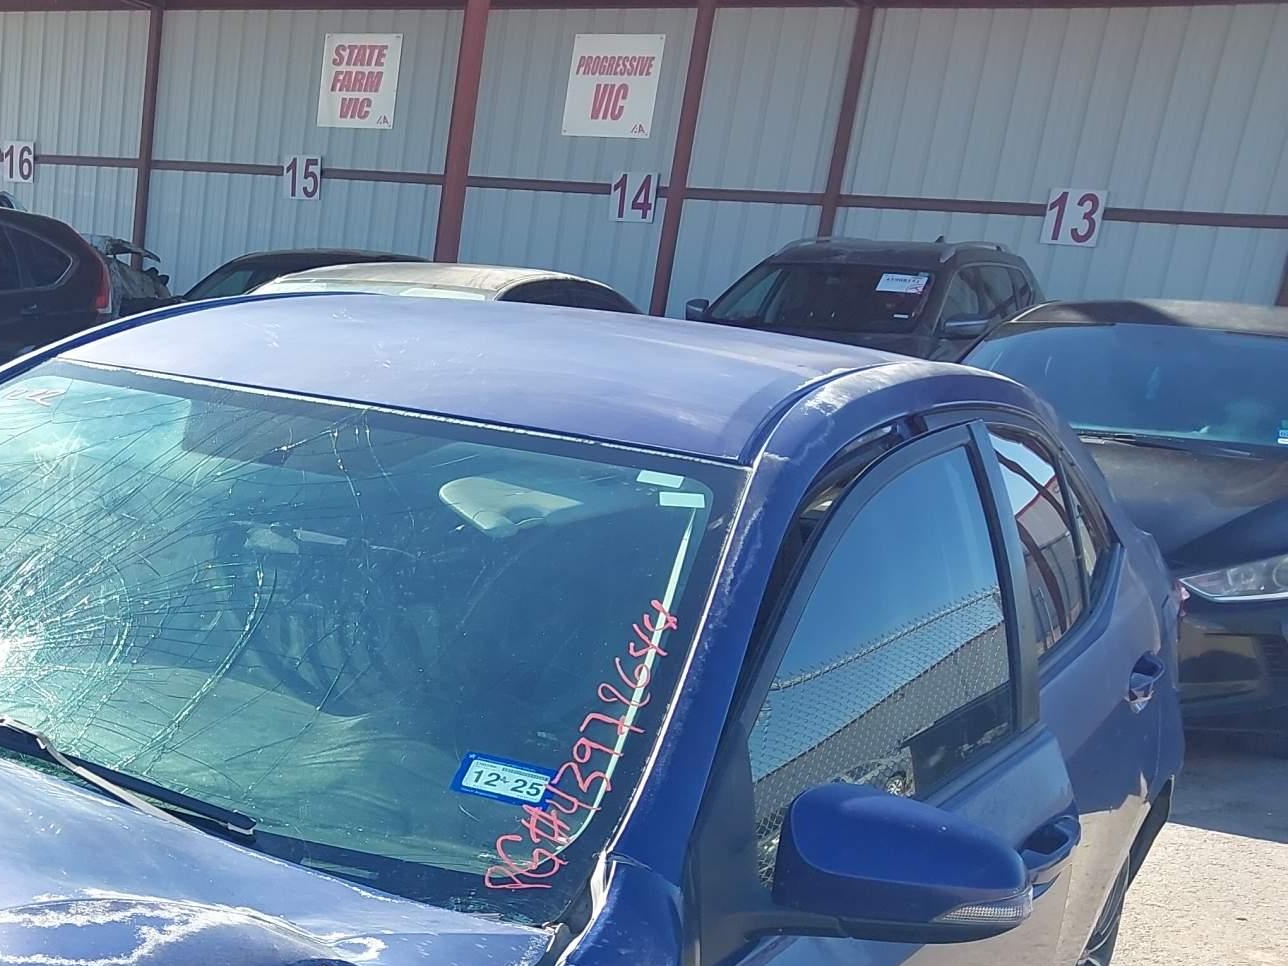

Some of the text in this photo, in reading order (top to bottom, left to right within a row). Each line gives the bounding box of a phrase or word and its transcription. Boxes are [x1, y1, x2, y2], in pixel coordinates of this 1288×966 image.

[332, 44, 389, 67] STATE
[575, 55, 656, 77] PROGRESSIVE
[330, 70, 384, 93] FARM
[339, 97, 373, 120] VIC
[591, 83, 629, 121] VIC
[4, 144, 33, 181] 16
[286, 157, 319, 198] 15
[613, 173, 652, 219] 14
[1048, 191, 1099, 243] 13
[473, 769, 501, 787] 12
[510, 778, 544, 797] 25
